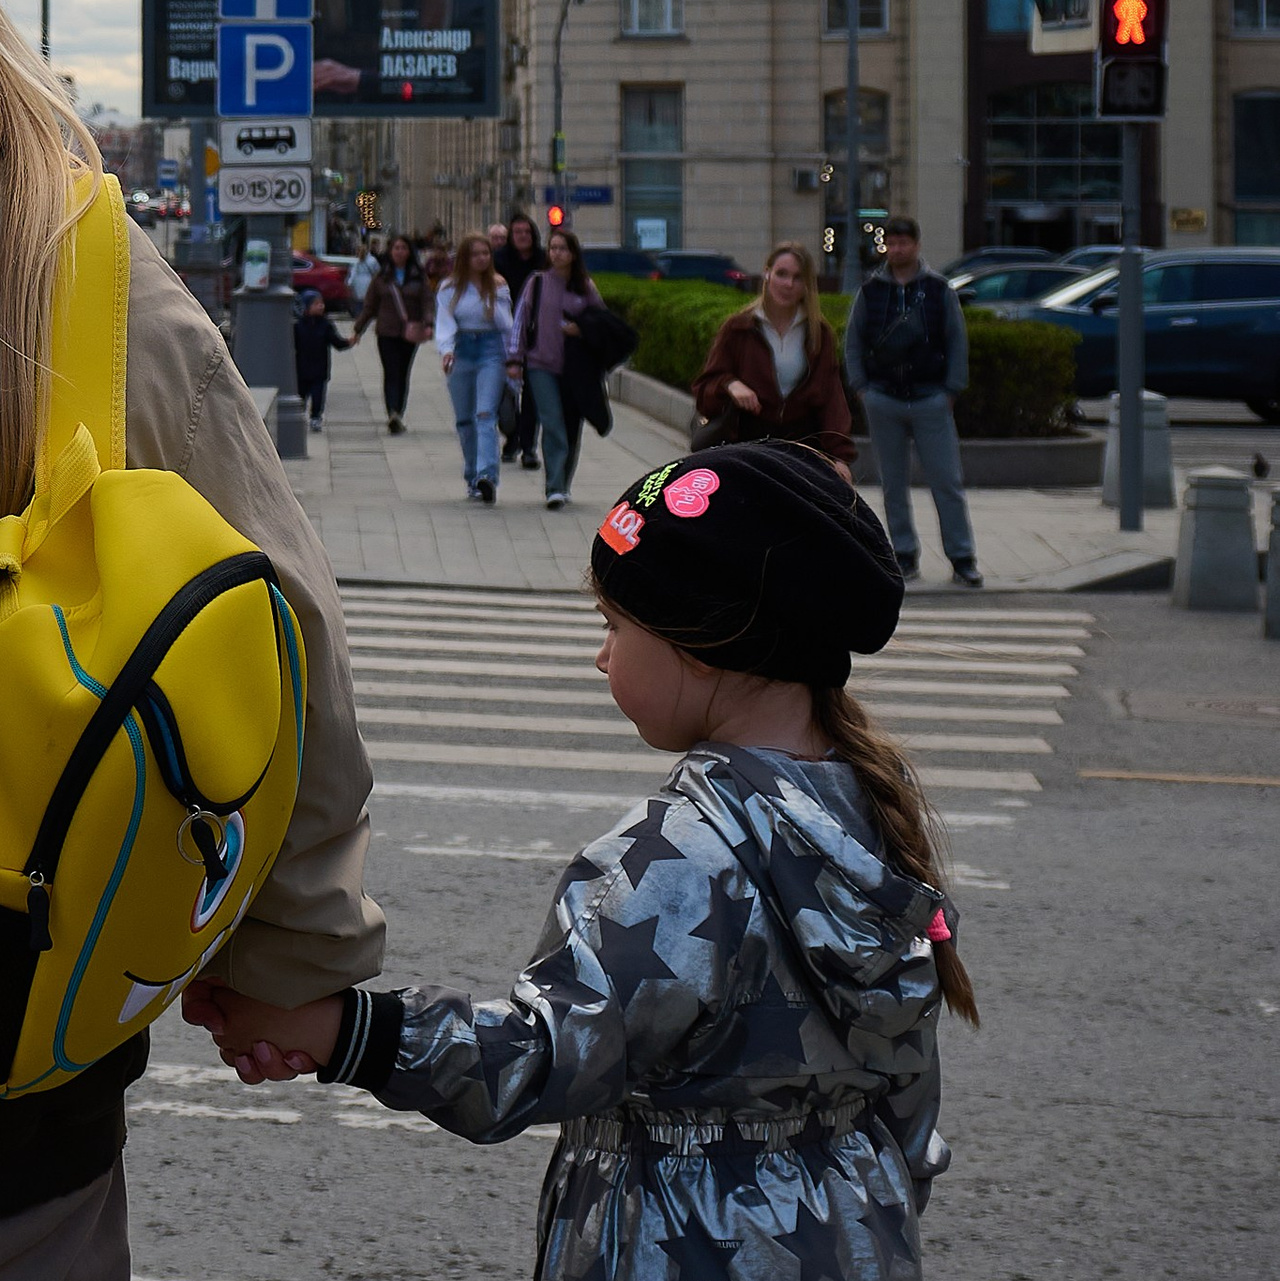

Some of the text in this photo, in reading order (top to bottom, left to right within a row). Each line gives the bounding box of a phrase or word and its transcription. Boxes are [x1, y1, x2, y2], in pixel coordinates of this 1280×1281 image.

[381, 27, 472, 51] Александр
[245, 34, 295, 106] P
[381, 55, 457, 77] ЛАЗАРЕВ
[231, 179, 302, 200] 10 15 20
[610, 504, 643, 545] LOL
